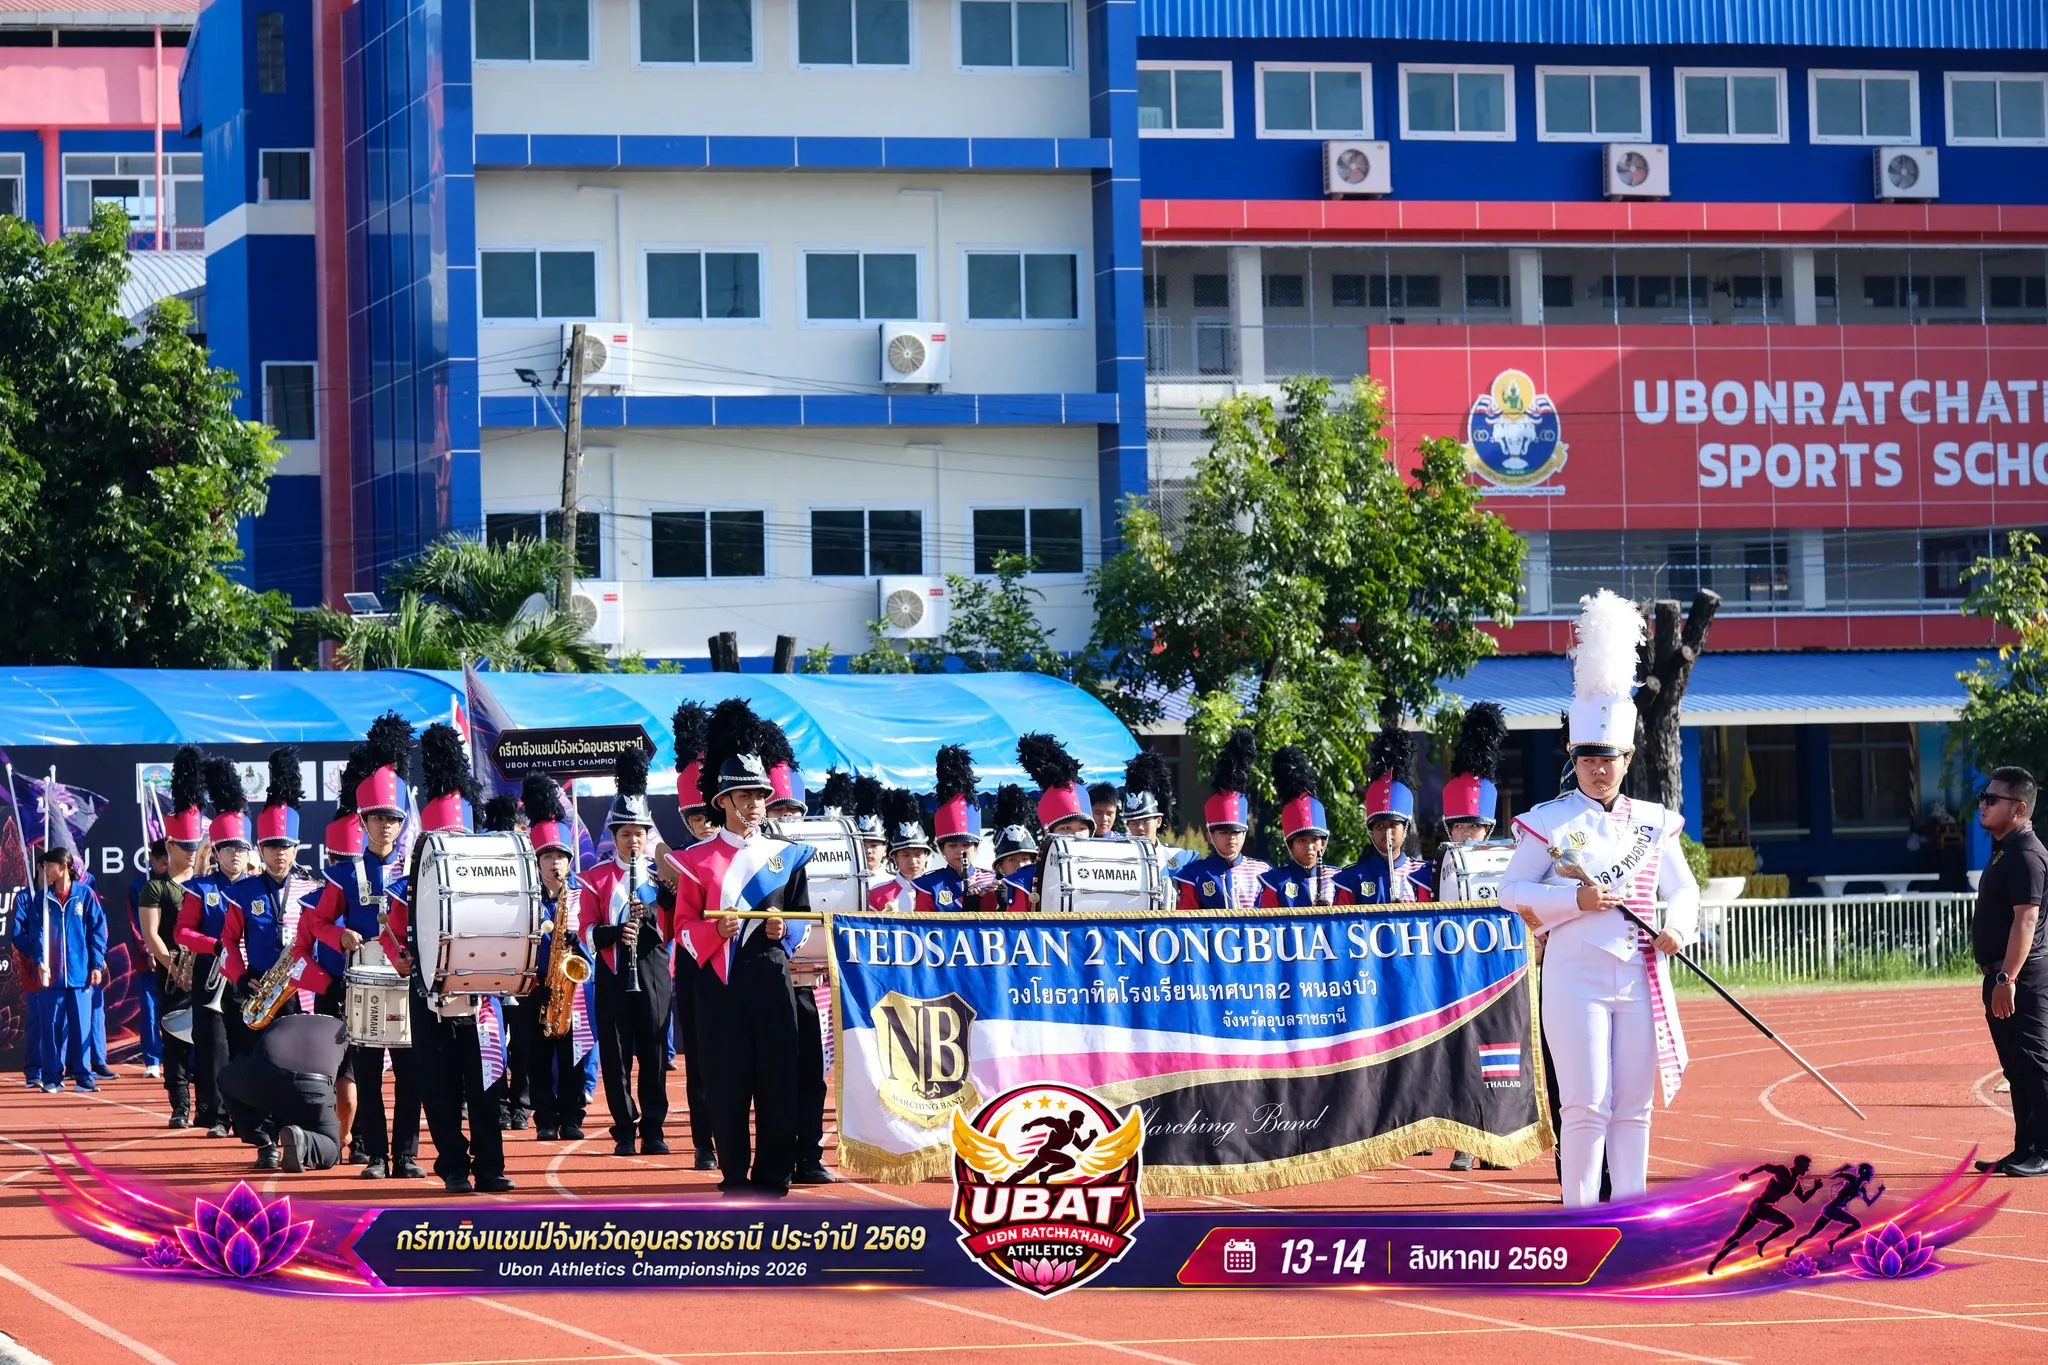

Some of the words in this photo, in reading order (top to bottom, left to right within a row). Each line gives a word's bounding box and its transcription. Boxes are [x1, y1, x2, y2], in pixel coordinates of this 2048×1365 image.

[1699, 443, 1903, 488] SPORTS
[506, 761, 529, 769] UBON
[532, 759, 575, 768] ATHLETICS
[811, 850, 852, 863] AMAHA
[1611, 864, 1625, 879] 2
[1620, 825, 1654, 870] หนองบัว
[470, 866, 517, 877] YAMAHA
[1091, 868, 1138, 881] YAMAHA
[838, 926, 1070, 968] TEDSABAN
[1084, 929, 1106, 966] 2
[1117, 925, 1338, 966] NONGBUA
[1349, 916, 1525, 960] SCHOOL
[1008, 976, 1291, 1005] วงโยธวาทิตโรงเรียนเทศบาล2
[1299, 970, 1378, 999] หนองบัว
[370, 1005, 378, 1037] YAMAHA
[1222, 1006, 1347, 1033] จังหวัดอุบลราชธานี
[880, 1005, 963, 1084] NB
[1484, 1080, 1521, 1088] THAILAND
[893, 1094, 939, 1110] MARCHING
[941, 1095, 966, 1110] BAND
[1245, 1102, 1330, 1134] Band
